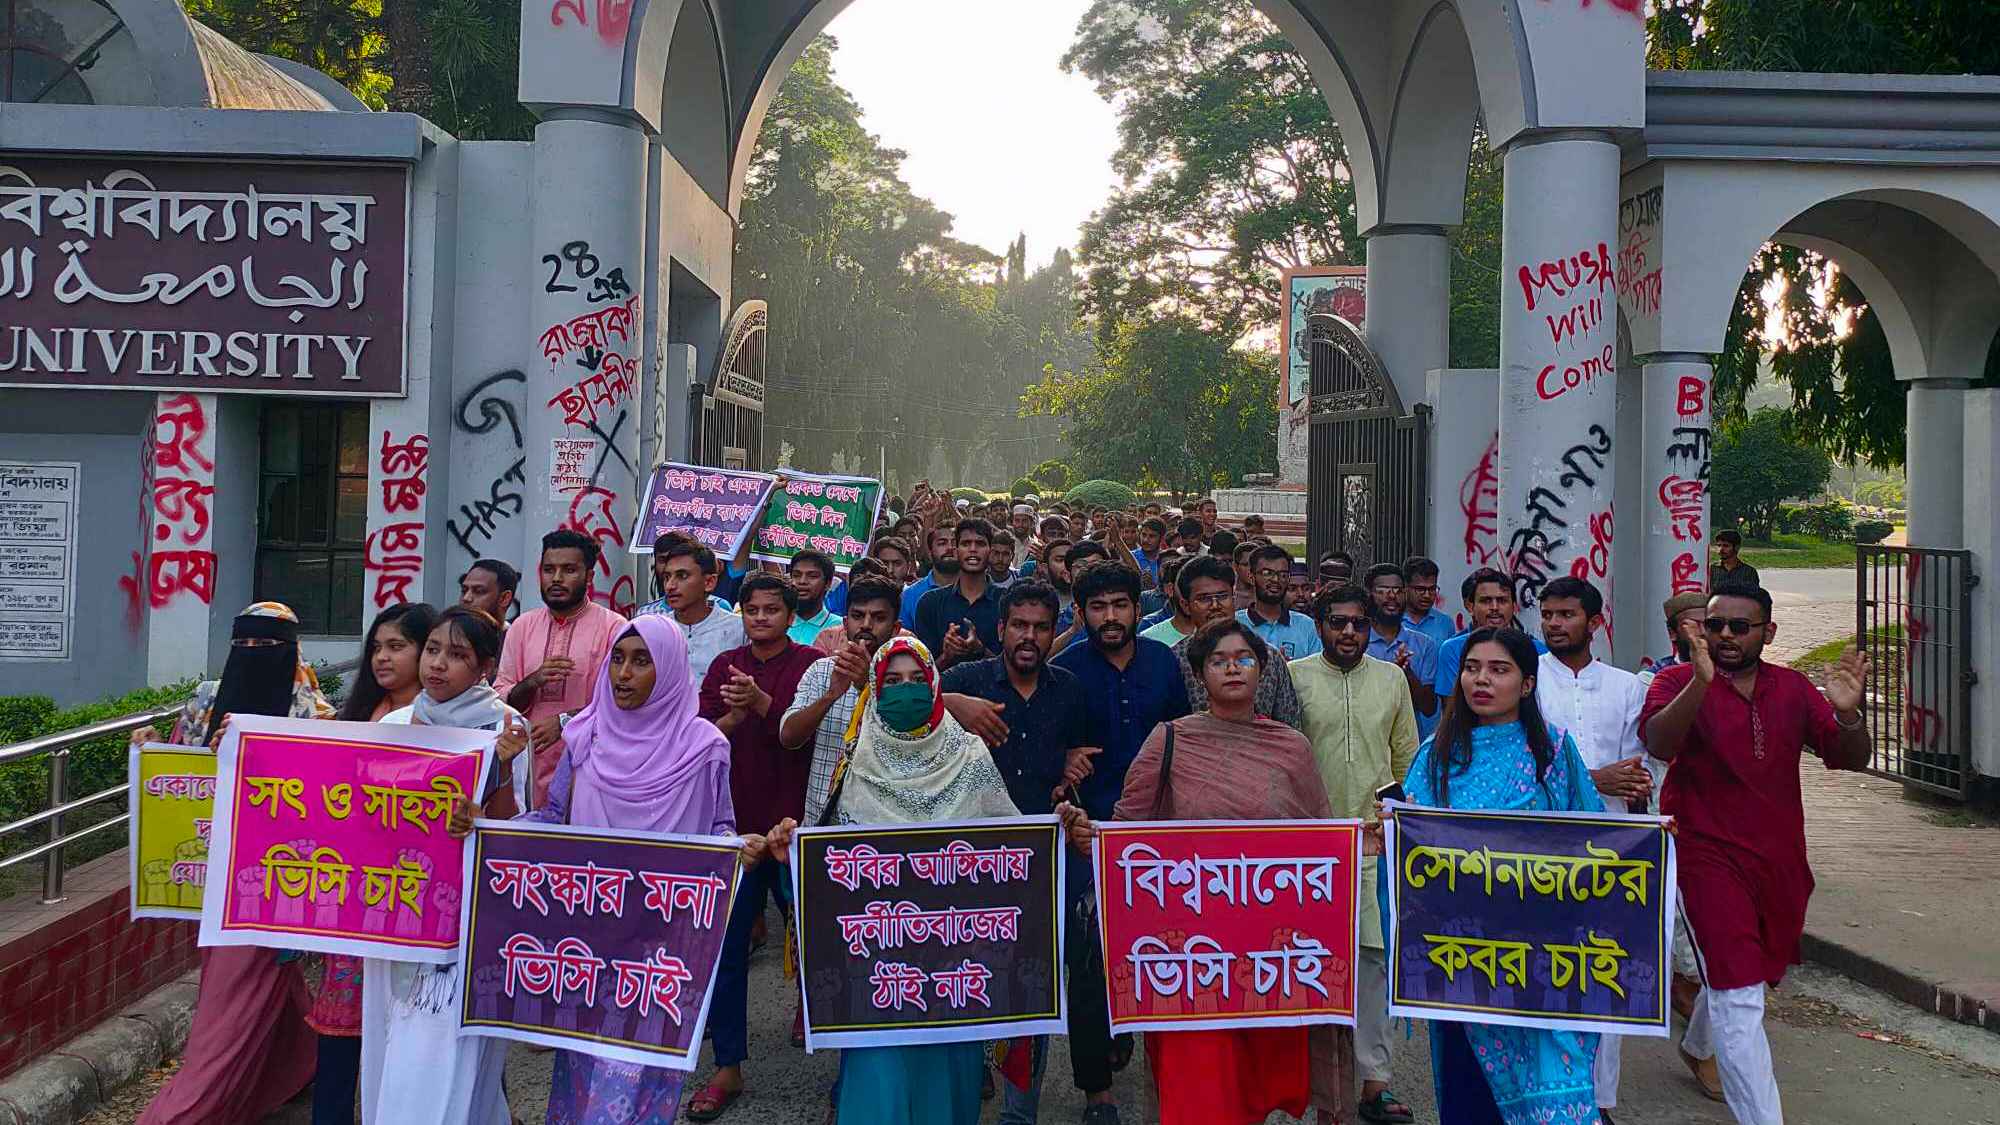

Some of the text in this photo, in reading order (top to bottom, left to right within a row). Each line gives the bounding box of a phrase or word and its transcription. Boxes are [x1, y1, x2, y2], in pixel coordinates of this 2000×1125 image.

[54, 240, 369, 323] الجامعة
[665, 469, 698, 491] ভিসি
[700, 474, 726, 494] চাই
[826, 486, 861, 503] দেখে
[787, 501, 847, 529] ভিসি দিন
[244, 776, 468, 835] সৎ ও সাহসী
[260, 844, 430, 918] ভিসি চাই
[485, 859, 728, 929] সংস্কার মনা
[824, 839, 1034, 892] ইবির আঙ্গিনায়
[1115, 843, 1340, 915] বিশ্বমানের
[1405, 840, 1655, 906] সেশনজটের
[837, 901, 1022, 958] দুর্নীতিবাজের
[499, 933, 693, 1026] ভিসি চাই
[870, 958, 993, 1012] ঠাঁই নাই
[1126, 932, 1333, 1002] ভিসি চাই
[1423, 930, 1629, 999] কবর চাই
